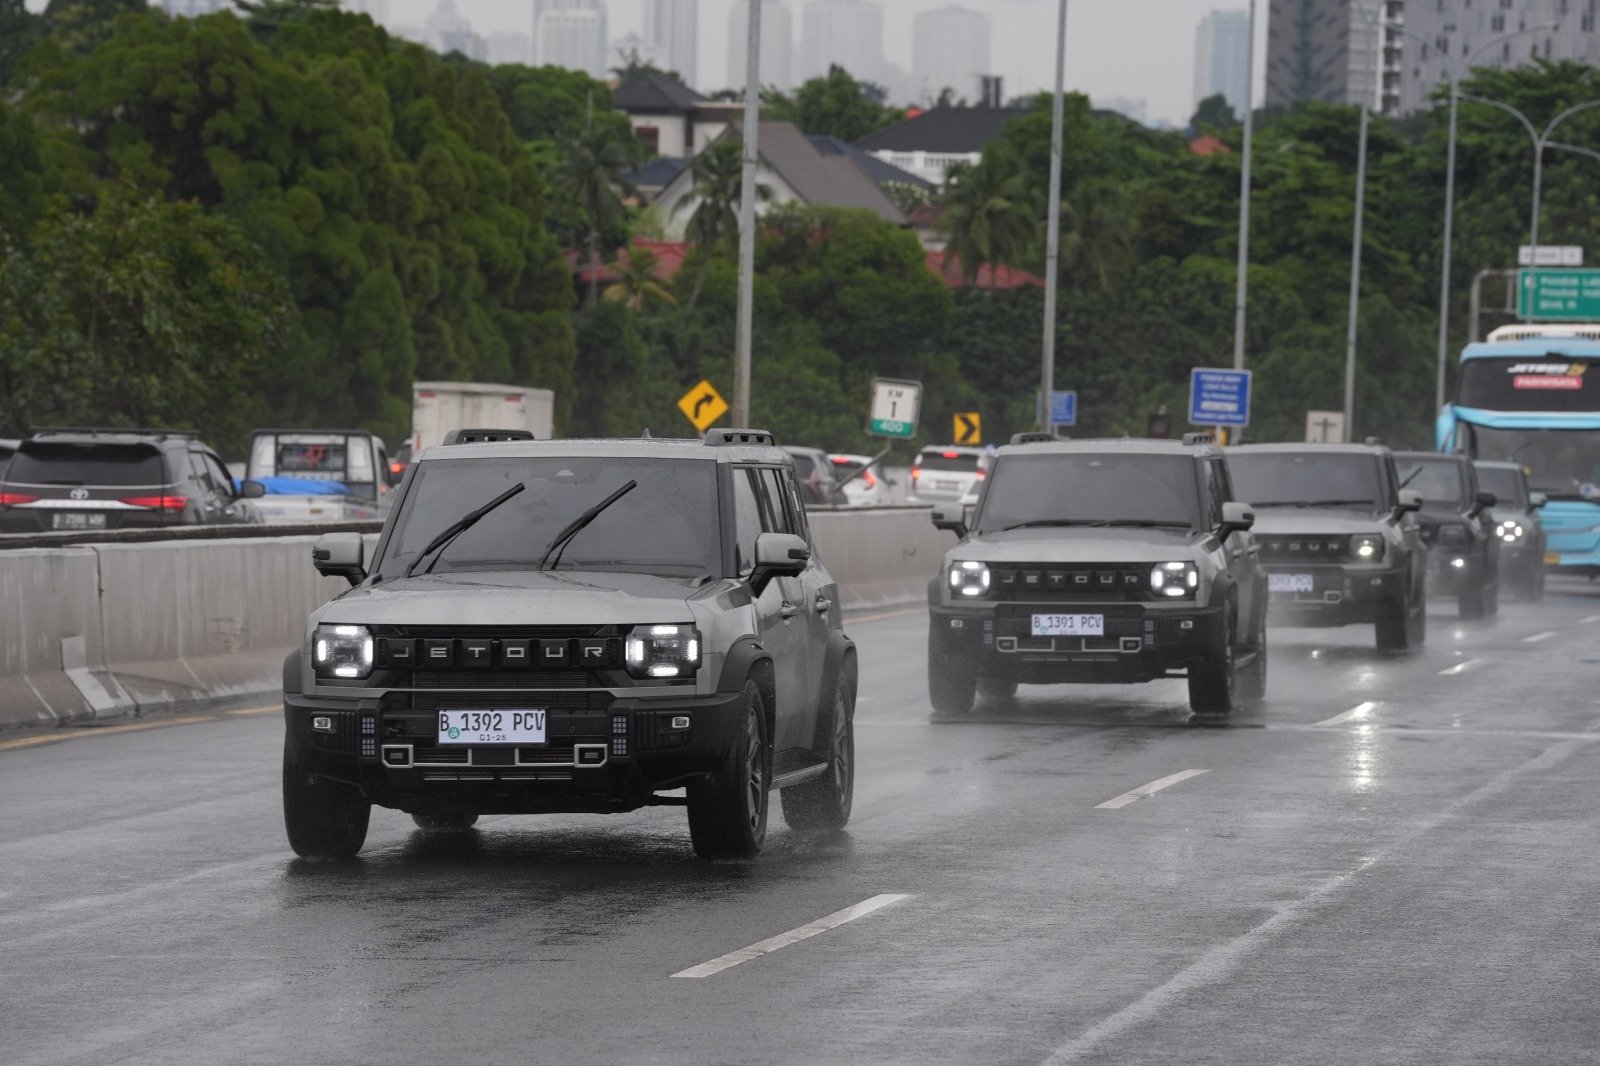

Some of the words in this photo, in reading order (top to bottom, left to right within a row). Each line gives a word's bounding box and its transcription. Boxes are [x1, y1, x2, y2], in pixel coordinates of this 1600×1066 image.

[890, 400, 897, 418] 1
[1002, 575, 1138, 584] JETOUR
[1034, 616, 1042, 629] B
[1047, 616, 1075, 629] 1391
[1081, 616, 1102, 629] PCV
[393, 646, 603, 658] JETOUR
[440, 713, 450, 732] B
[460, 712, 503, 732] 1392
[513, 712, 545, 731] PCV
